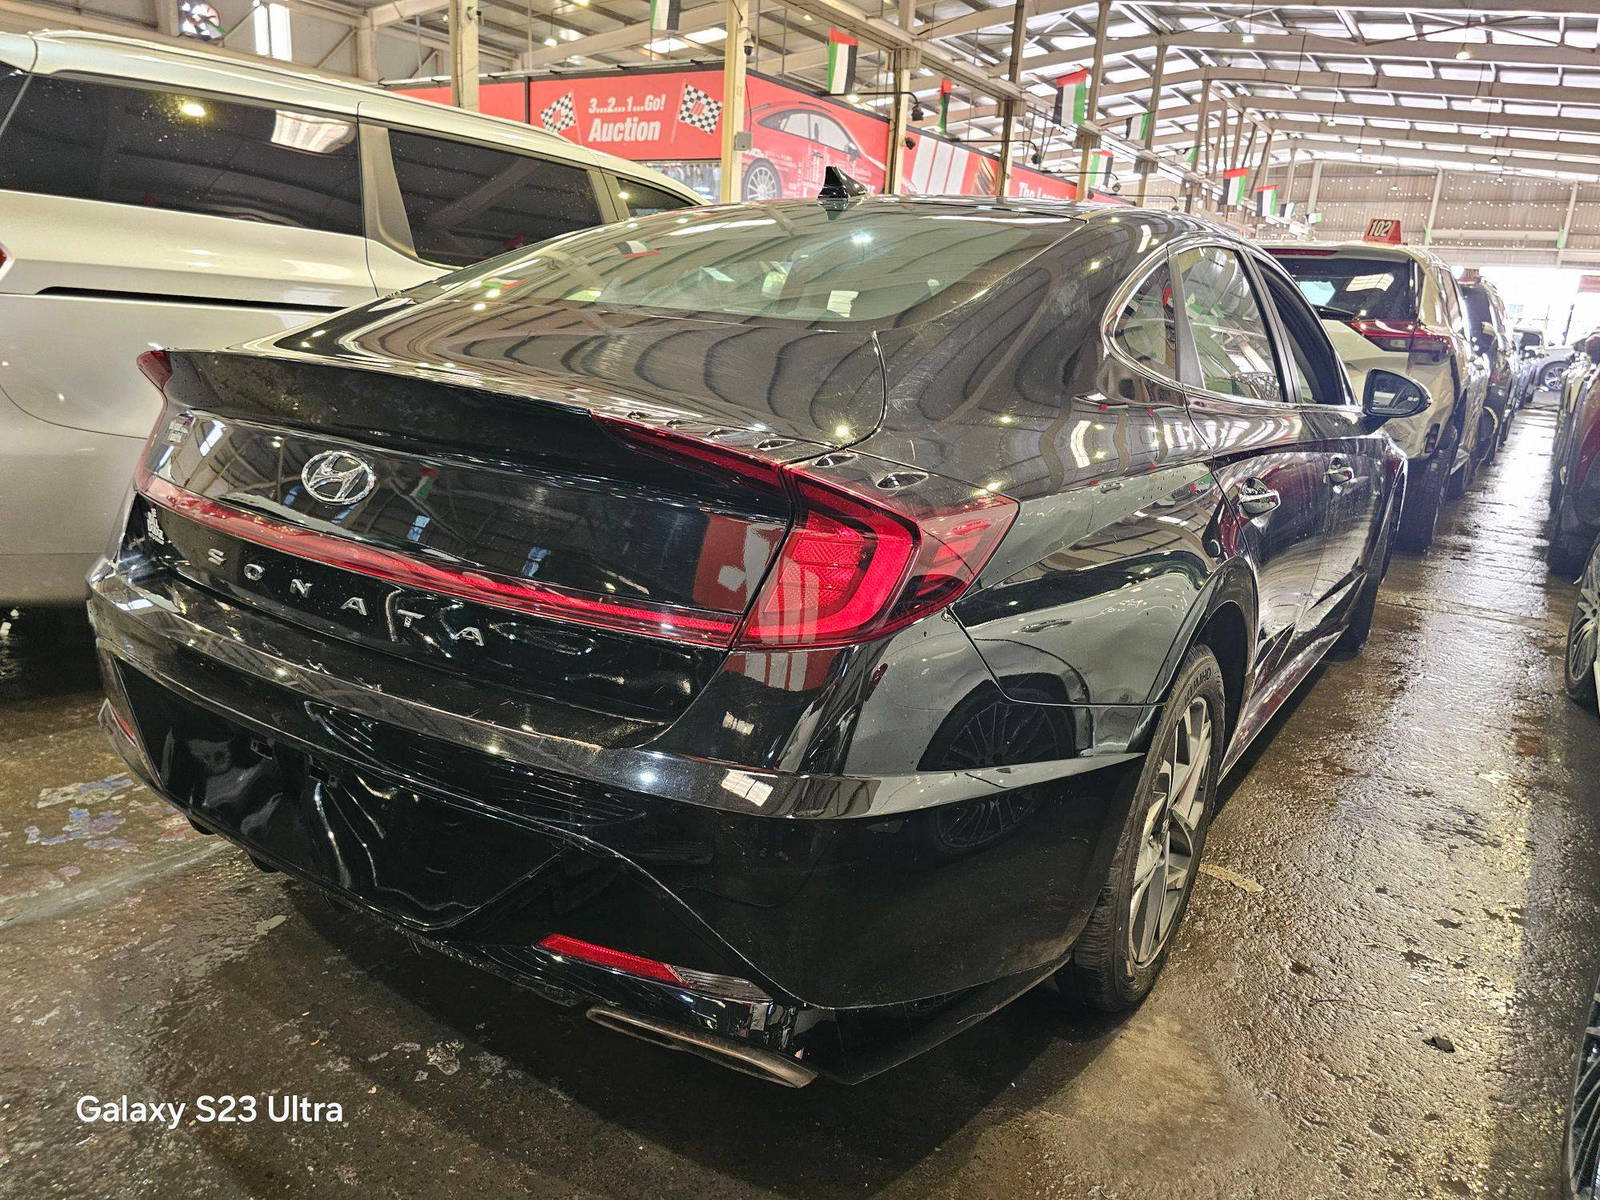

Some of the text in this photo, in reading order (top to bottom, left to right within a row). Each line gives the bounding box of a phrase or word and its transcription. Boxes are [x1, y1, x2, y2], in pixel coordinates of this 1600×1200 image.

[588, 117, 661, 142] Auction
[1369, 220, 1392, 237] 102
[207, 548, 485, 647] SONATA
